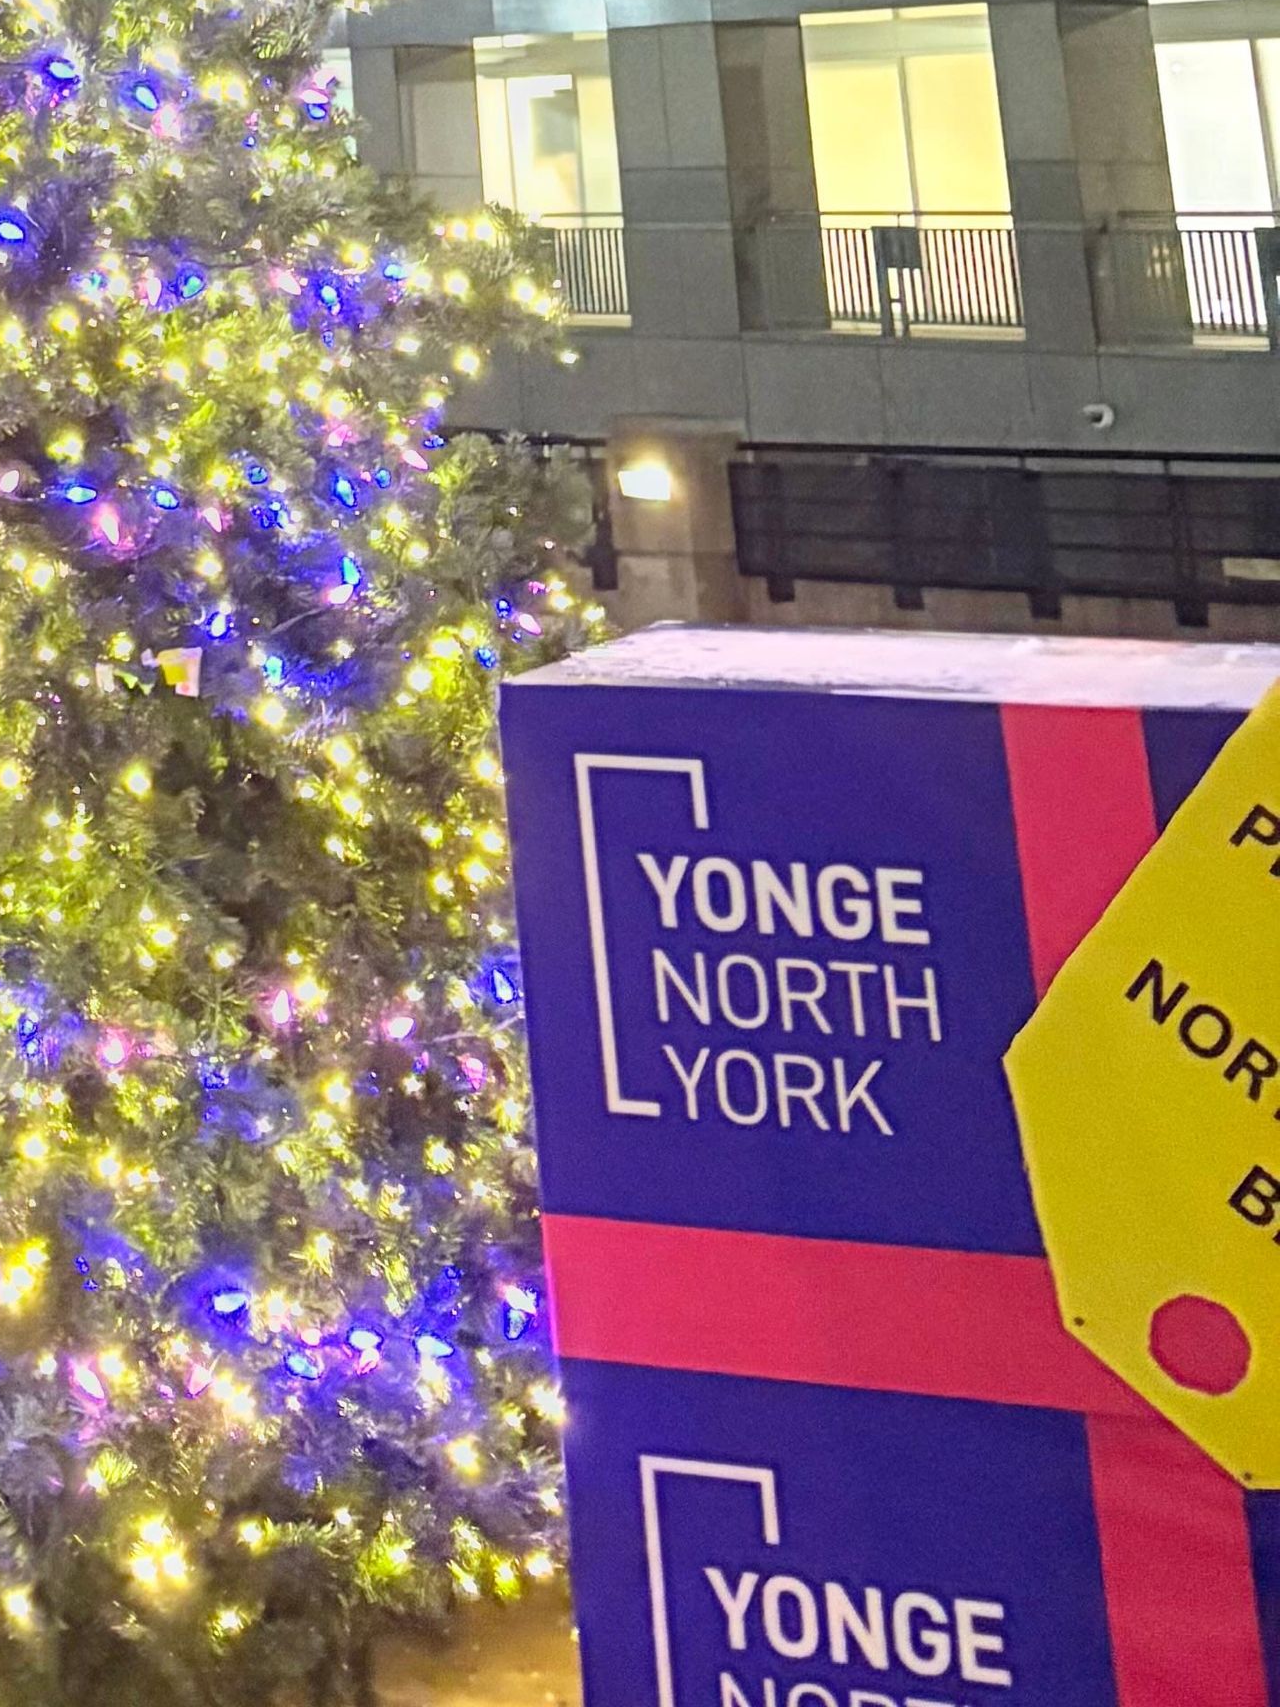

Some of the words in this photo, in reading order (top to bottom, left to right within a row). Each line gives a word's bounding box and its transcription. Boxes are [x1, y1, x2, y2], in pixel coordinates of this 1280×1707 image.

[636, 853, 930, 945] YONGE
[652, 948, 942, 1042] NORTH
[1125, 958, 1280, 1121] NOR
[661, 1044, 893, 1136] YORK
[704, 1566, 1012, 1686] YONGE
